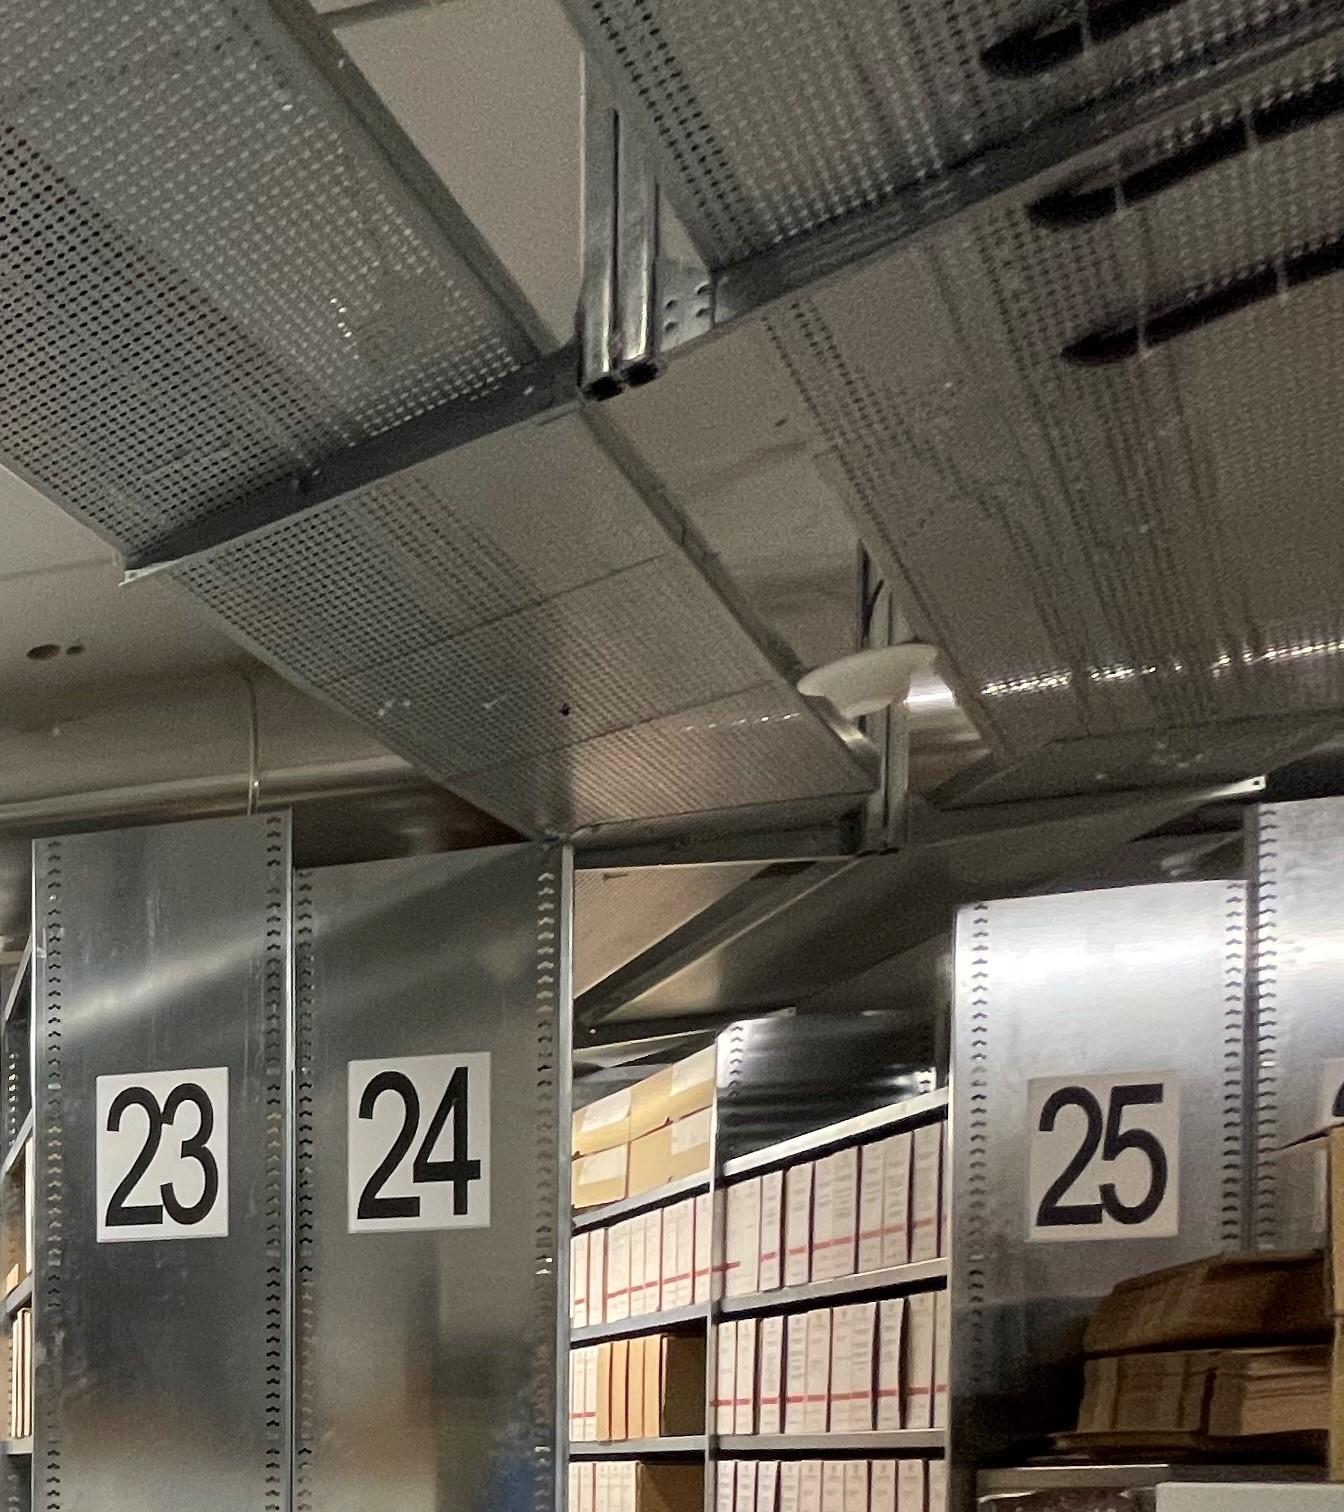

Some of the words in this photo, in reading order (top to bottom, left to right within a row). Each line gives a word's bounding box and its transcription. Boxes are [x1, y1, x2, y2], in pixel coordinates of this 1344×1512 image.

[105, 1083, 218, 1225] 23
[357, 1067, 481, 1219] 24
[1036, 1083, 1167, 1226] 25
